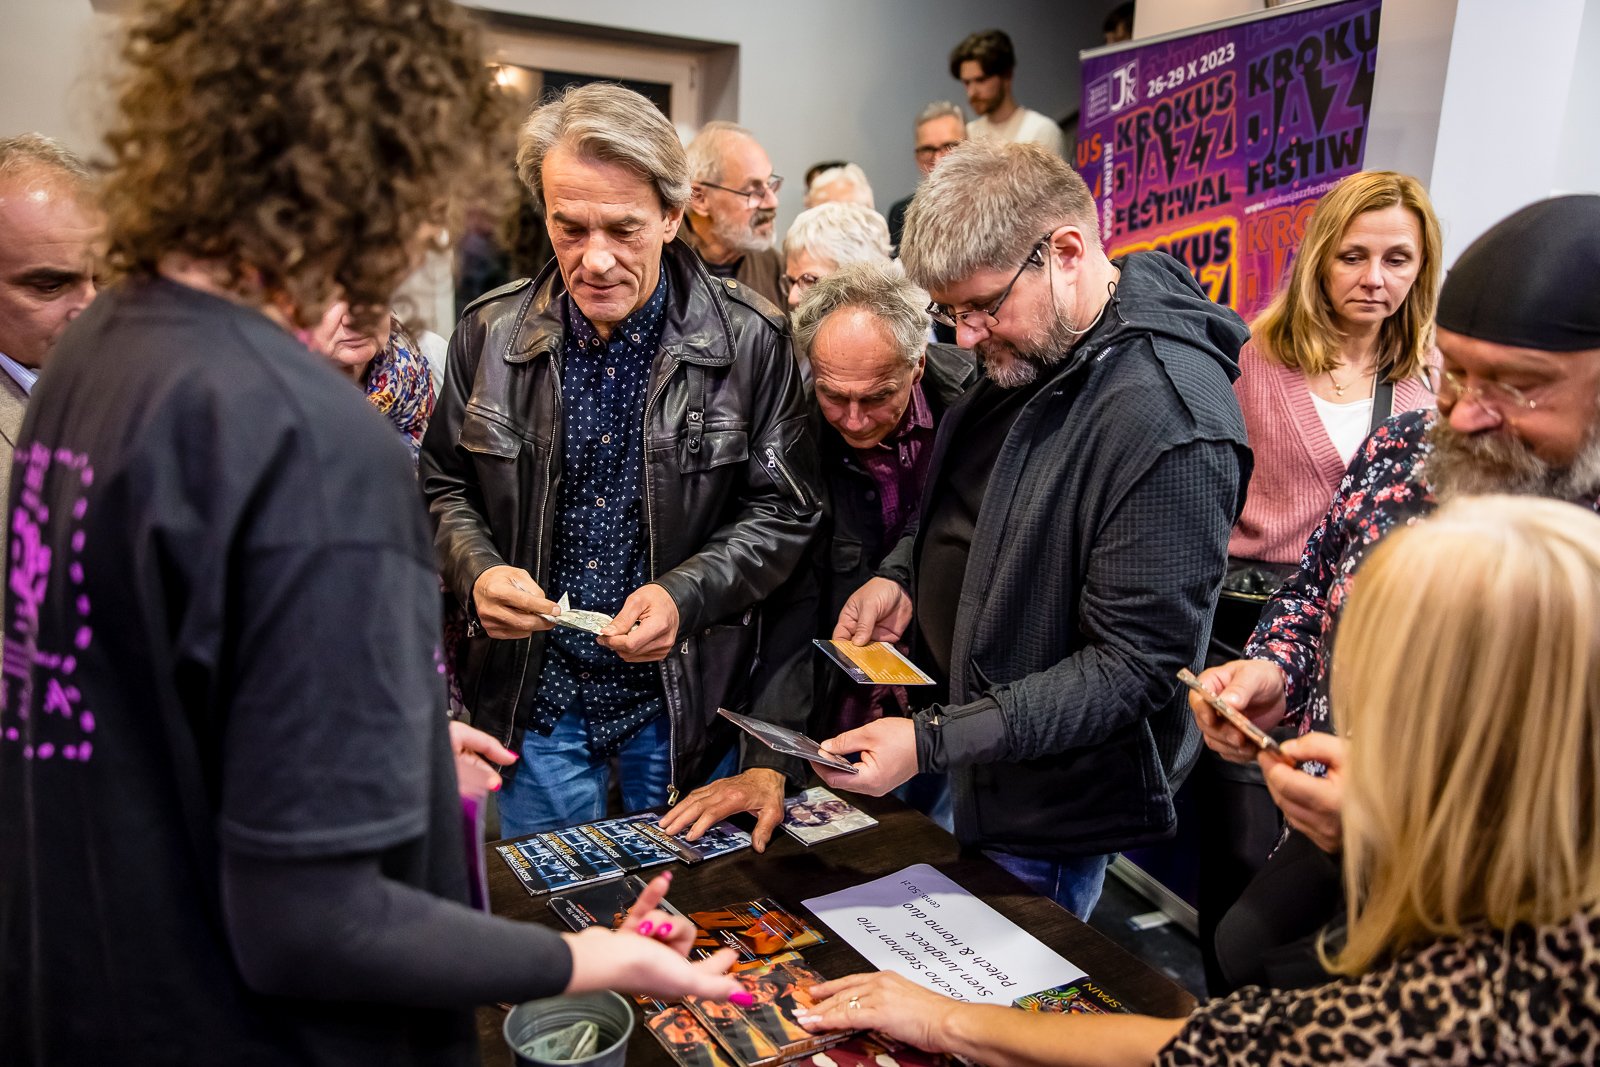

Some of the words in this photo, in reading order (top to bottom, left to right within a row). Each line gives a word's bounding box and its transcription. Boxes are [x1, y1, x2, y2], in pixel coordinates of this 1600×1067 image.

[1147, 68, 1185, 99] 26-29
[1186, 60, 1198, 83] X
[1199, 42, 1235, 75] 2023
[1116, 73, 1235, 152] KROKUS
[1116, 107, 1236, 205] JAZZ
[1115, 171, 1233, 237] FESTIWAL
[908, 885, 922, 895] 50
[918, 891, 941, 909] cena:
[902, 903, 928, 919] duo
[856, 916, 882, 936] Trio
[923, 919, 964, 947] Horna
[878, 934, 928, 970] Stephan
[905, 931, 964, 972] Jungbeck
[958, 945, 975, 957] &
[925, 971, 970, 1002] Joscho
[959, 973, 994, 997] Sven
[1082, 982, 1122, 1008] SPAIN
